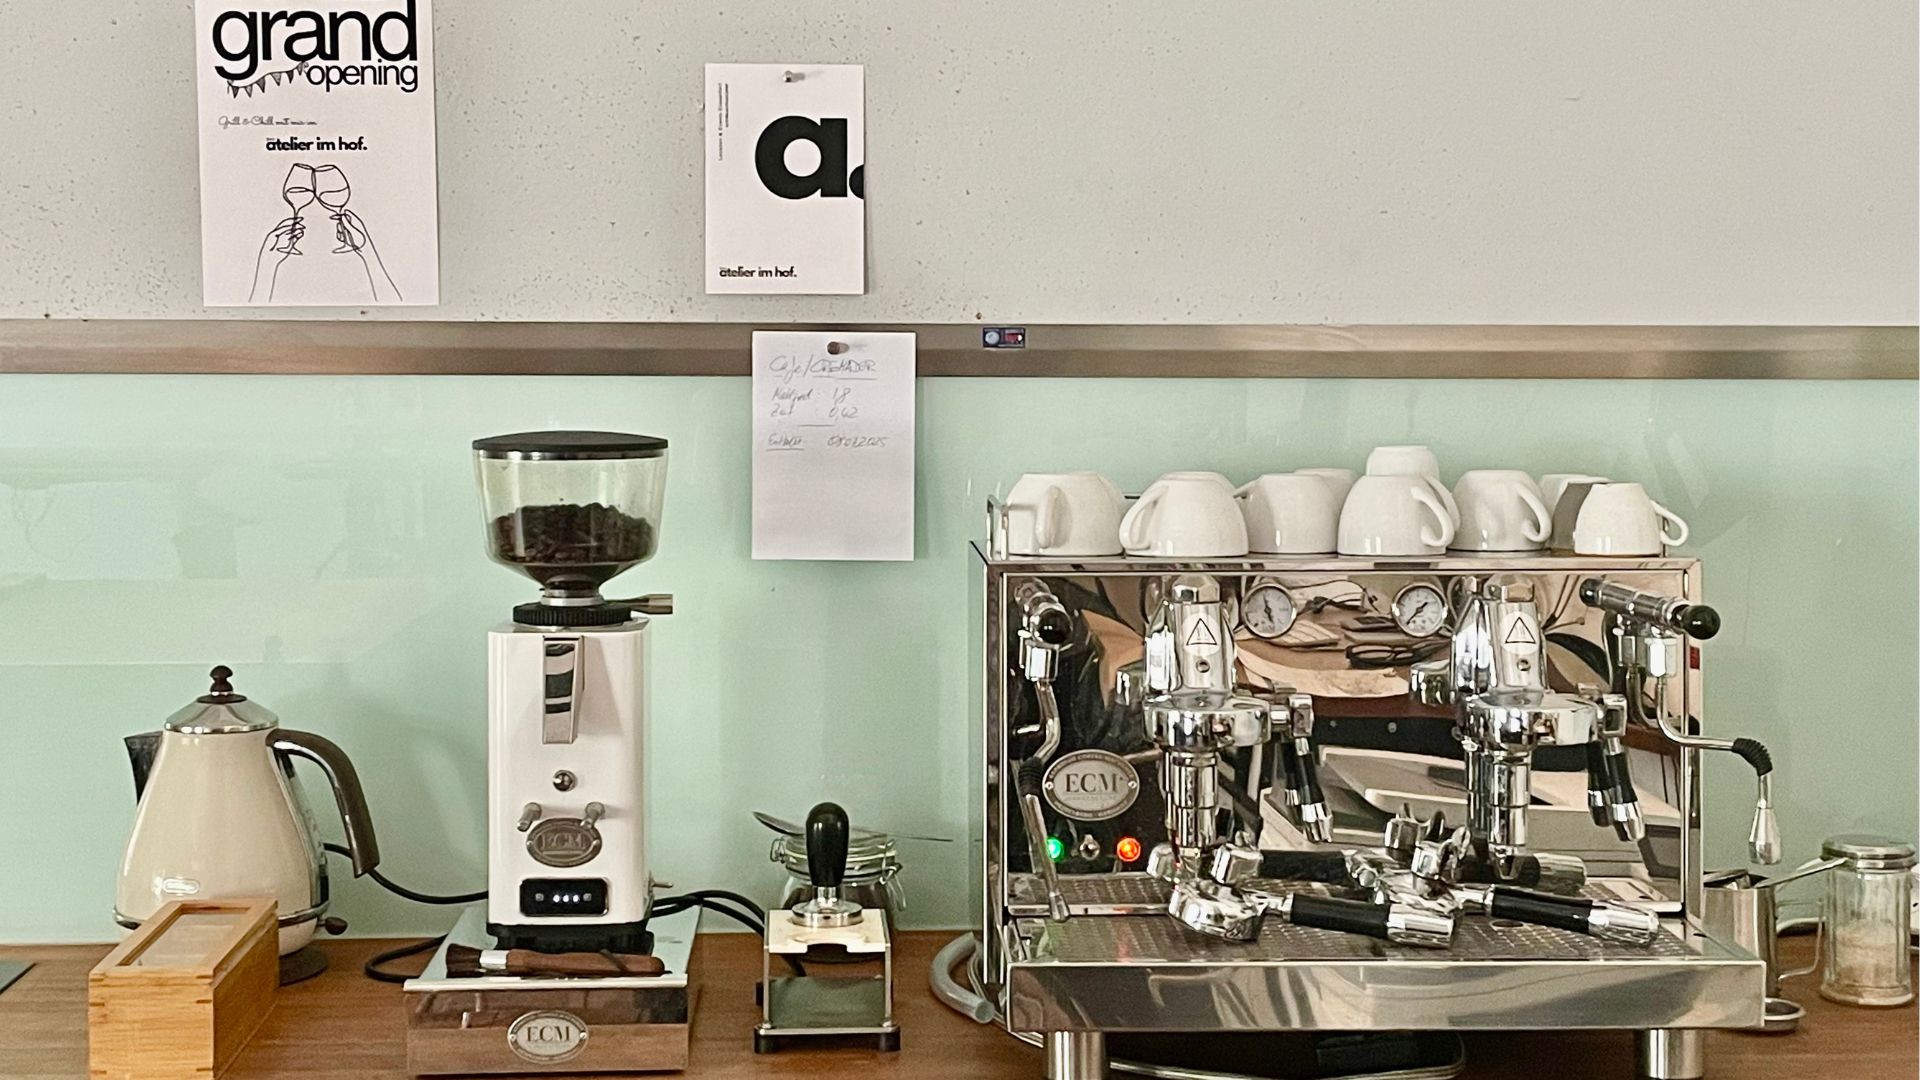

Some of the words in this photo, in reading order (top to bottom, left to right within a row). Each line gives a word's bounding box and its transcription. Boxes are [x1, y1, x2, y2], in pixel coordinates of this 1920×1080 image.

[212, 0, 418, 80] grand
[306, 59, 418, 93] opening
[266, 136, 314, 151] atelier
[316, 136, 336, 151] im
[338, 136, 368, 151] hof.
[719, 266, 756, 278] atelier
[758, 266, 773, 278] im
[774, 265, 797, 278] hof.
[1065, 773, 1118, 793] ECM
[527, 1025, 571, 1042] ECM
